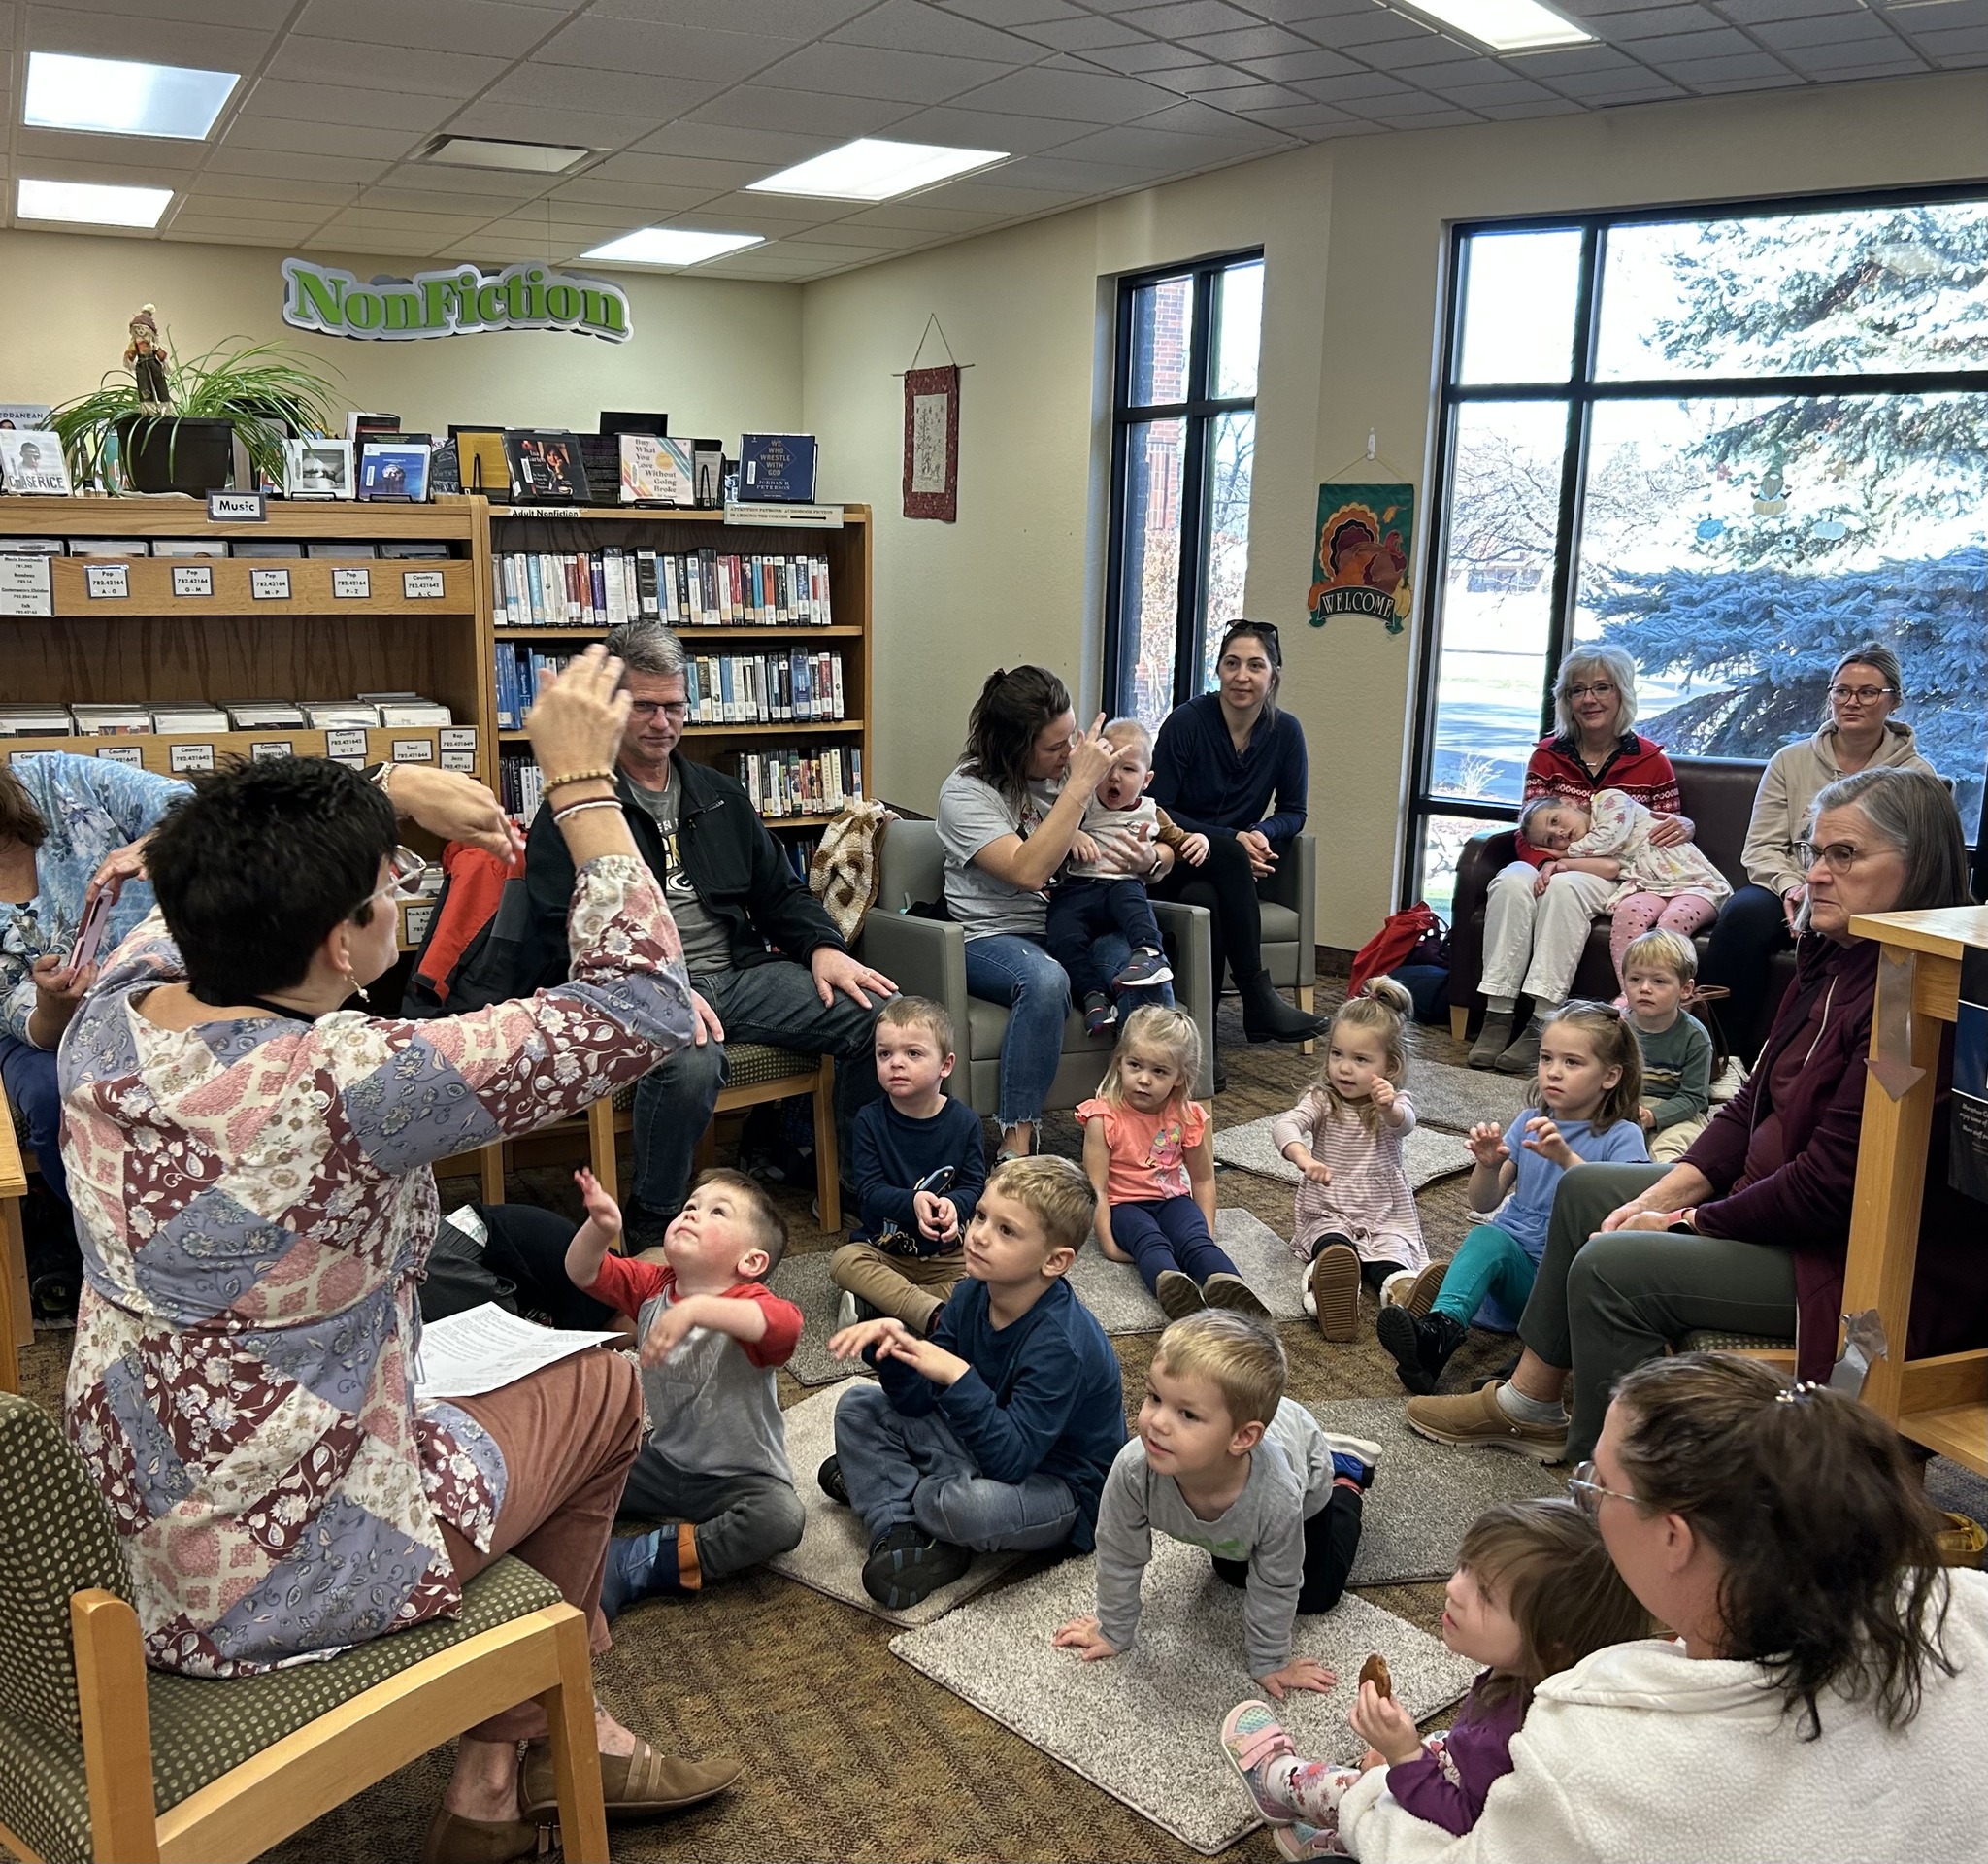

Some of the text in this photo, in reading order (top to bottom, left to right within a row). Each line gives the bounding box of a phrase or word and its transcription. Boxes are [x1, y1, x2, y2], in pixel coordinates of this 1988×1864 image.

[291, 268, 629, 333] NonFiction
[635, 438, 649, 447] Buy
[654, 478, 677, 486] Going
[219, 500, 255, 512] Music
[512, 509, 579, 517] Adult Nonfiction
[1322, 591, 1394, 617] WELCOME
